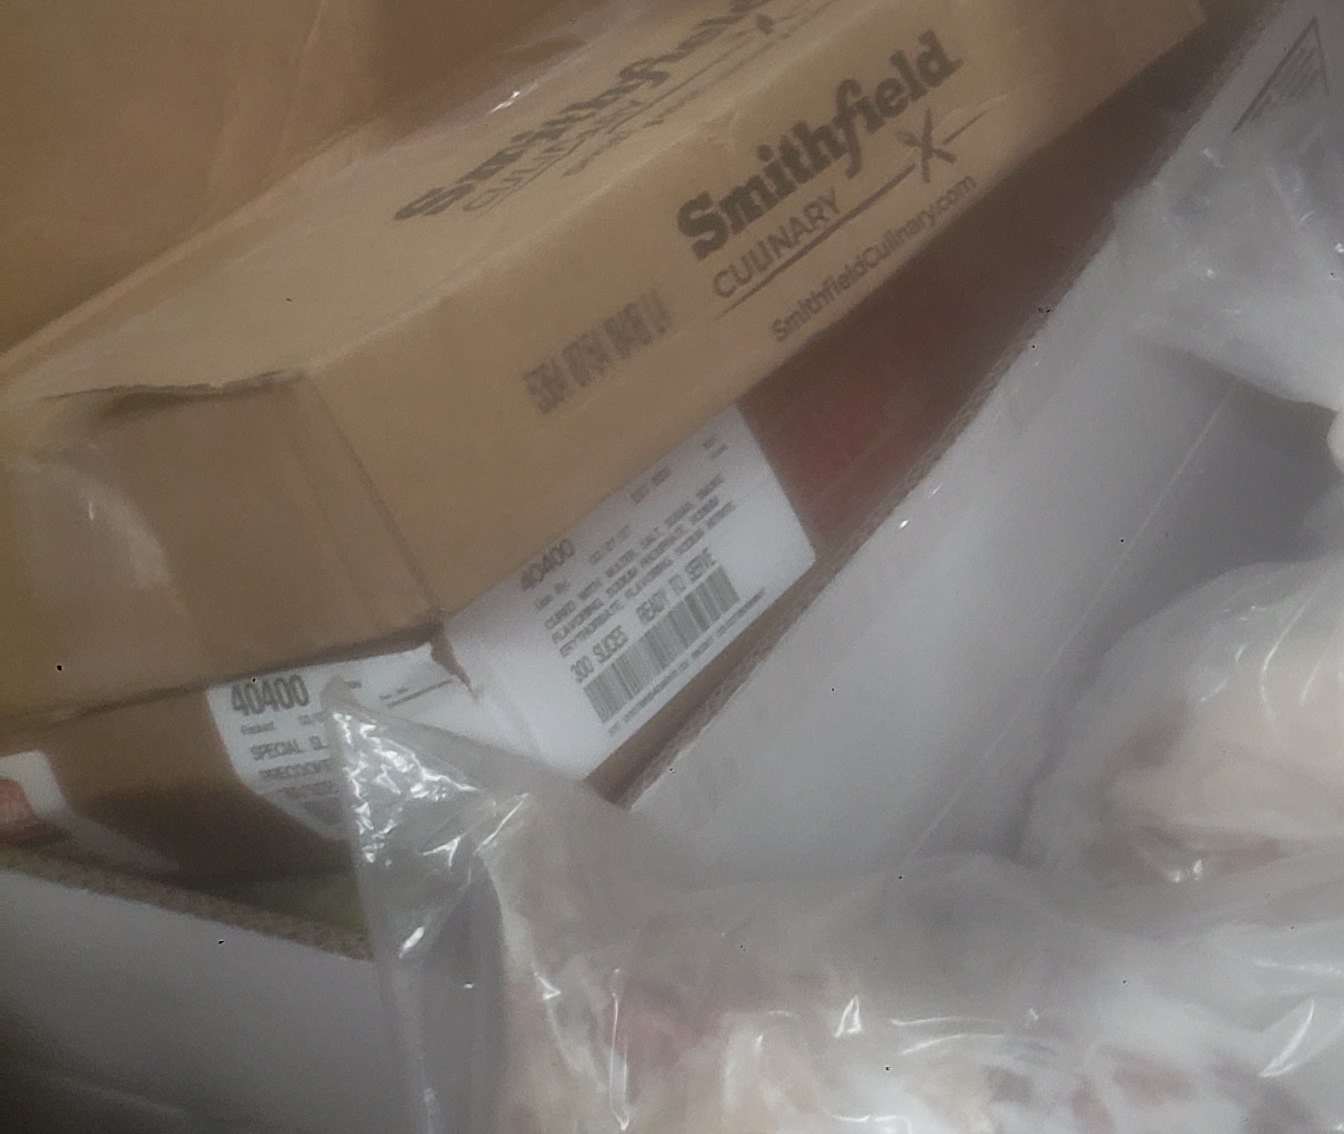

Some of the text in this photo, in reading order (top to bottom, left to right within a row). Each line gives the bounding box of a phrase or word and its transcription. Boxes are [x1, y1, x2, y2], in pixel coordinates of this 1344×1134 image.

[675, 29, 963, 261] Smithfield
[713, 188, 842, 299] CULINARY
[772, 172, 977, 343] SmithfieldCulinary.com
[230, 672, 311, 718] 40400
